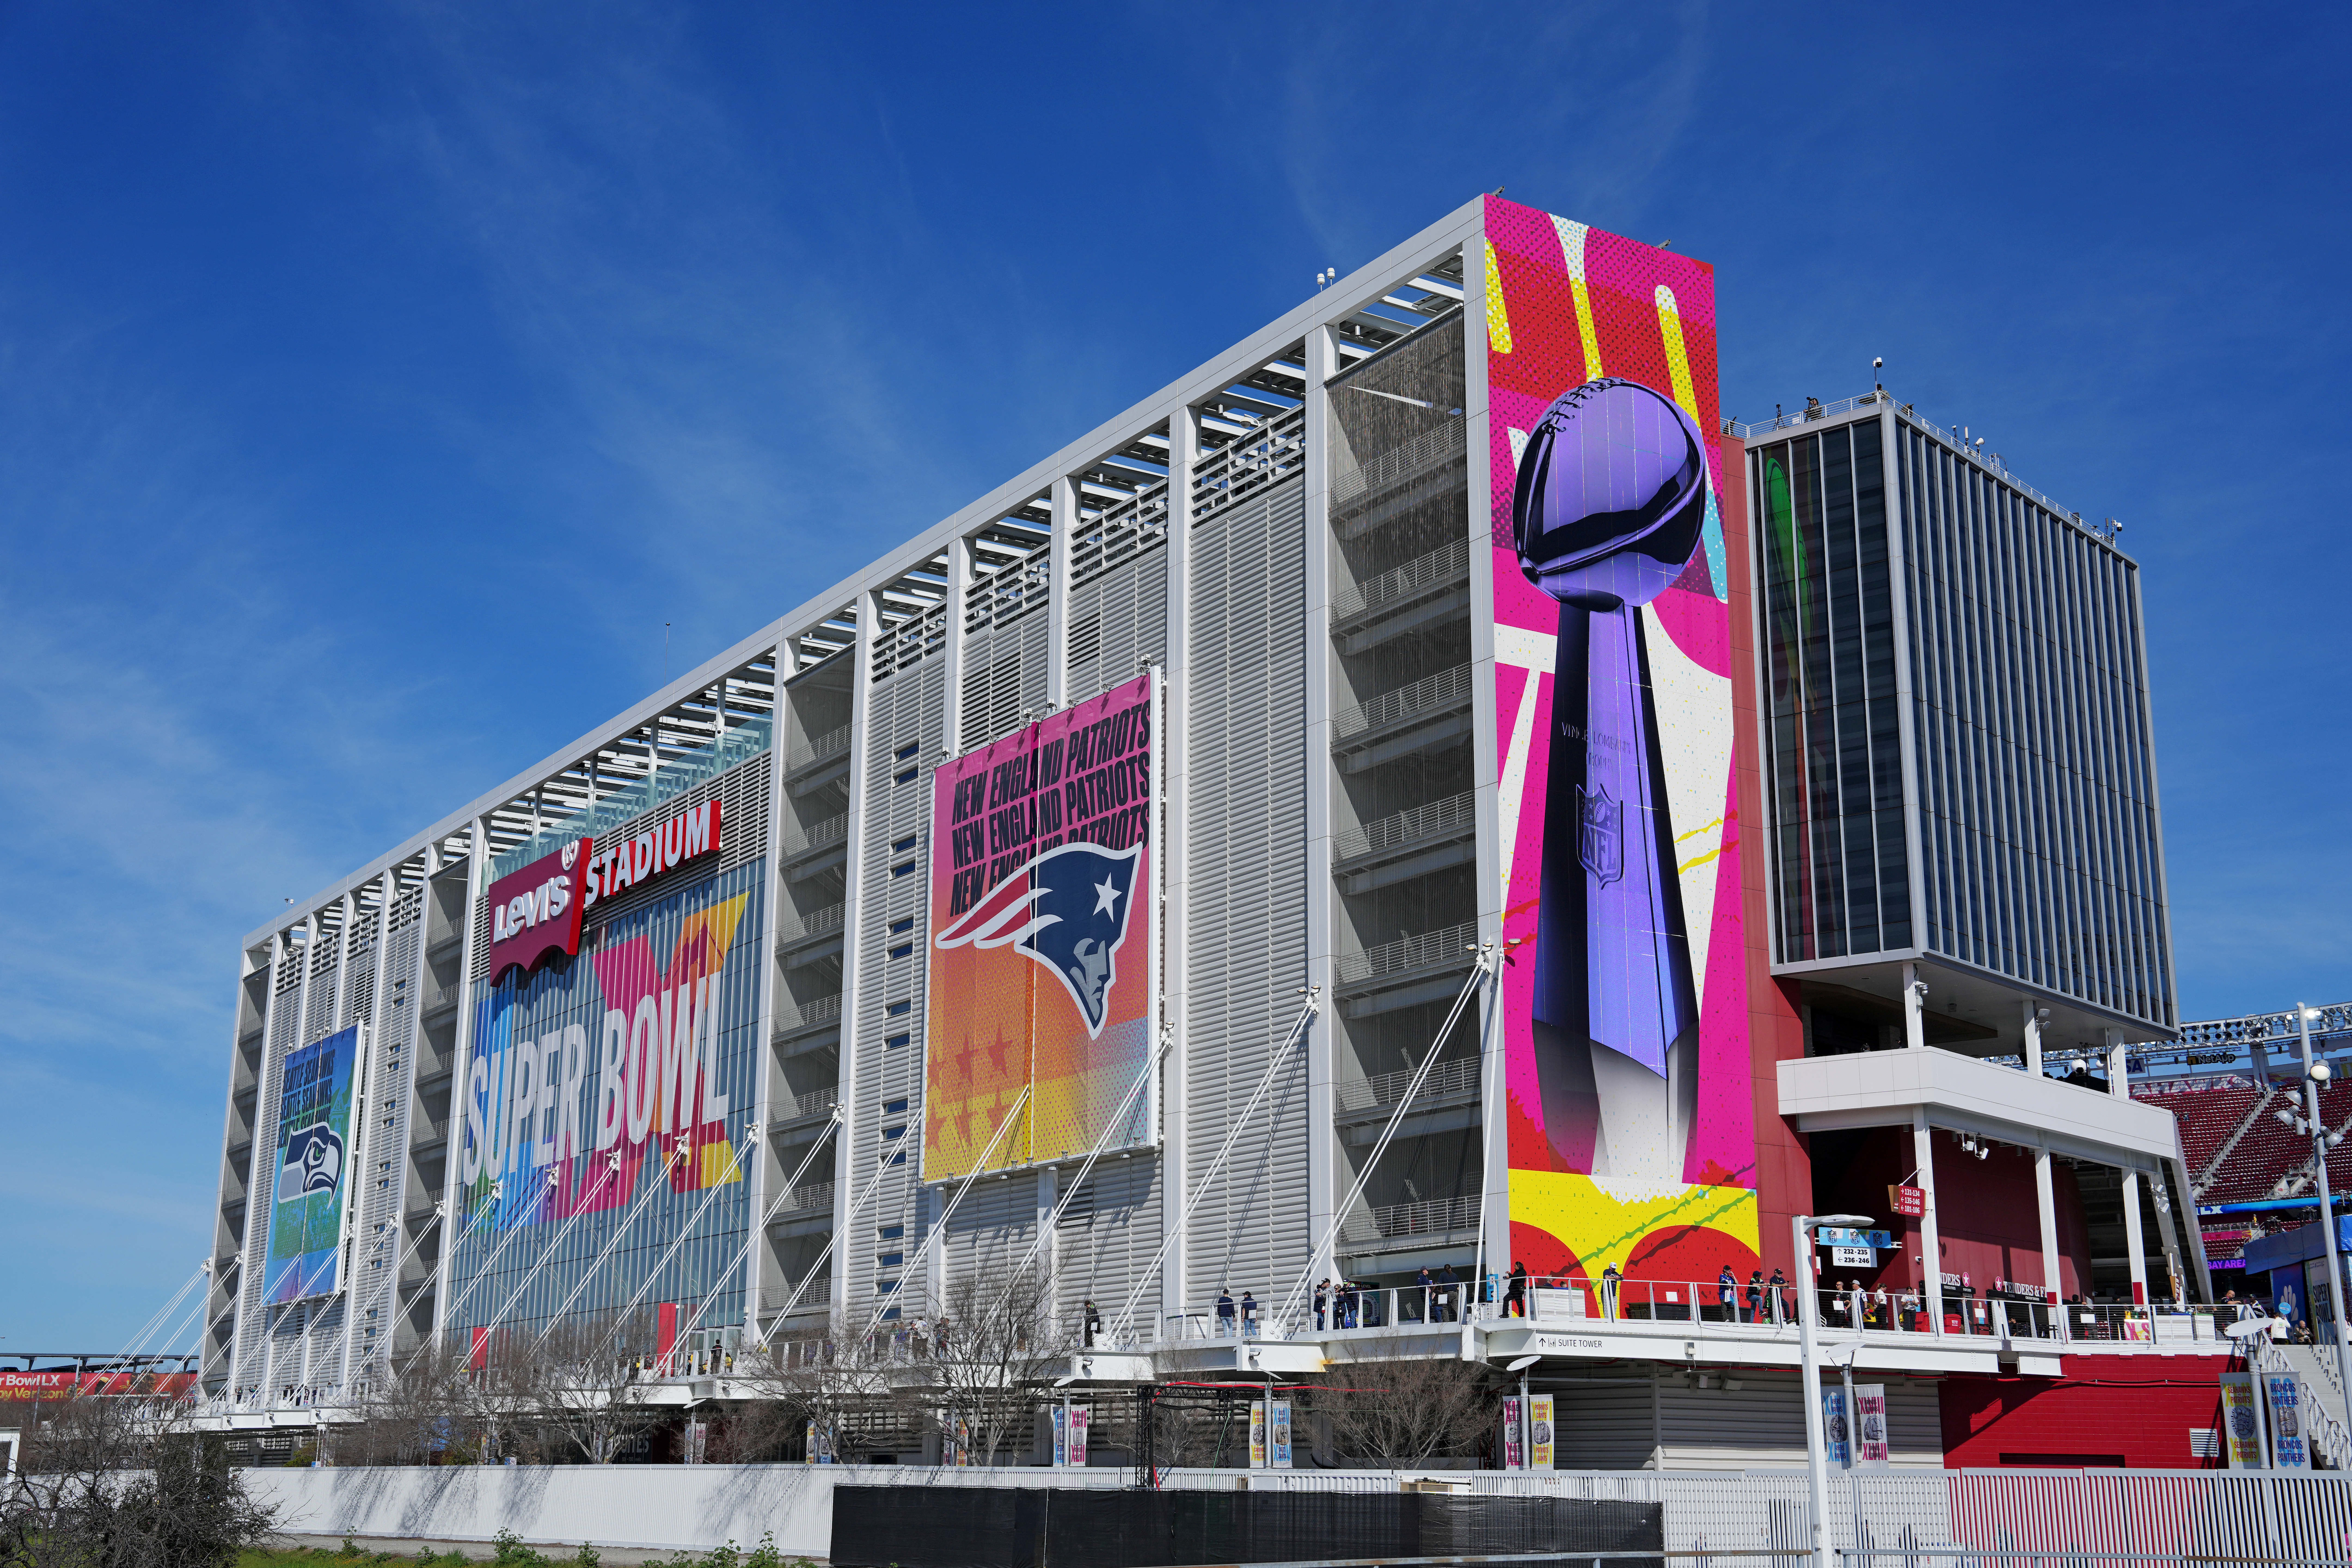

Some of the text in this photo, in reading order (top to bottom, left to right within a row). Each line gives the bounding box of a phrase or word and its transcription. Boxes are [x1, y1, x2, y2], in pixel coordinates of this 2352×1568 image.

[952, 699, 1150, 826] NEW ENGLAND PATRIOTS
[952, 751, 1150, 870] NEW ENGLAND PATRIOTS
[584, 800, 721, 906] STADIUM
[1583, 825, 1617, 873] NFL
[950, 862, 986, 918] NEW
[2198, 1054, 2234, 1063] NetApp
[283, 1062, 305, 1096] SEATTLE
[463, 971, 729, 1186] SUPER BOWL
[280, 1091, 301, 1122] SEATTLE
[1904, 1188, 1920, 1197] 131-134
[1904, 1197, 1920, 1205] 135-146
[1904, 1205, 1920, 1214] 101-106
[2208, 1261, 2223, 1270] BAY
[2003, 1281, 2034, 1296] TENDERS
[2034, 1285, 2040, 1297] &
[2313, 1283, 2328, 1303] SUPER
[6, 1374, 40, 1386] Bowl
[41, 1374, 60, 1386] LX
[15, 1388, 64, 1399] Verzon
[2270, 1383, 2296, 1393] BRONCOS
[2271, 1396, 2299, 1405] PANTHERS
[2277, 1440, 2303, 1450] BRONCOS
[2278, 1453, 2305, 1463] PANTHERS
